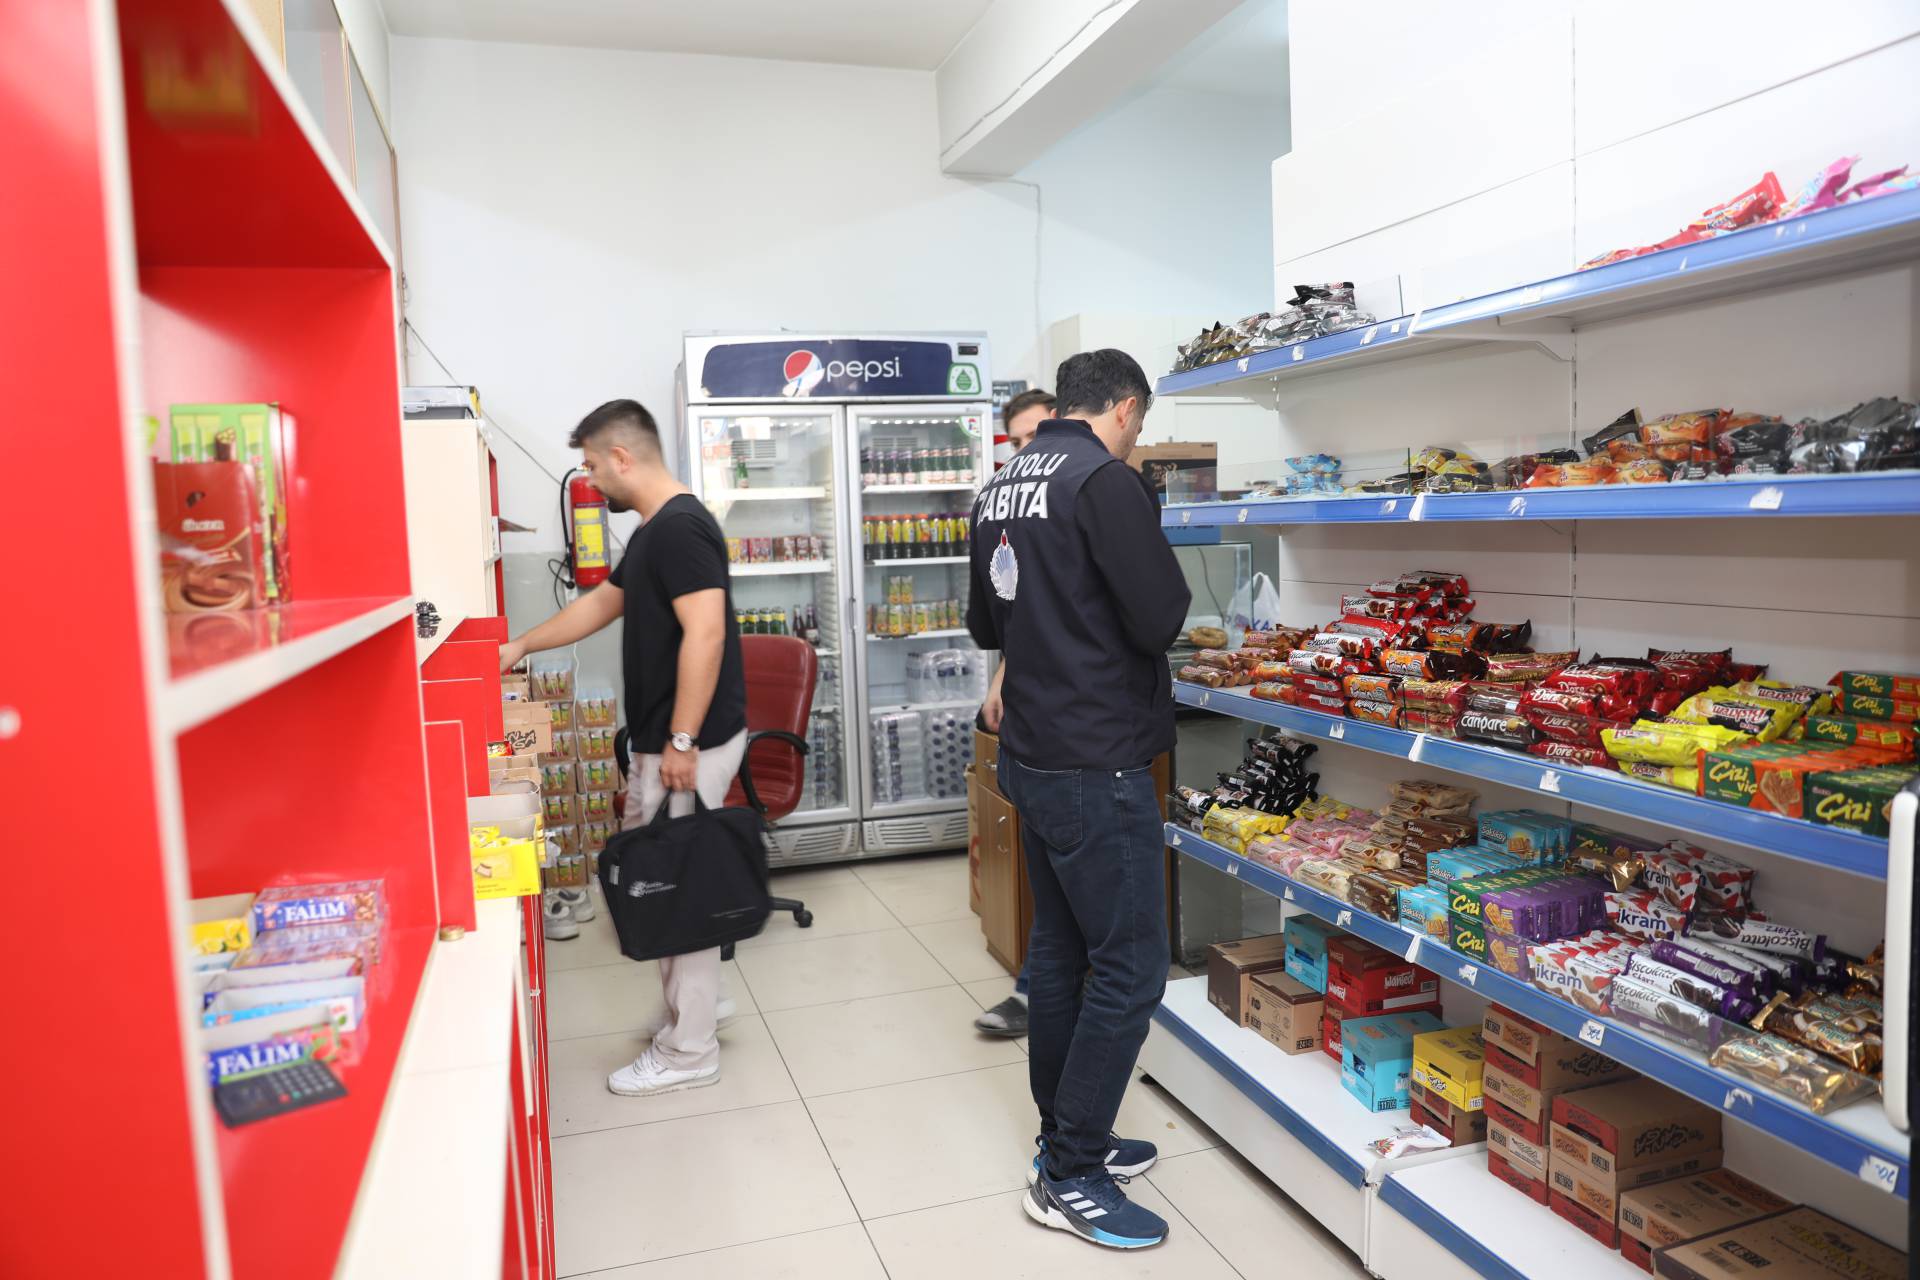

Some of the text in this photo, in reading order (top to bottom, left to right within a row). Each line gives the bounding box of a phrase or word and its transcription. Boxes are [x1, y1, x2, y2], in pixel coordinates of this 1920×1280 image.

[827, 357, 902, 383] pepsi
[976, 481, 1049, 527] ZABITA
[1461, 715, 1508, 733] canpare
[1709, 760, 1749, 782] Çizi
[1816, 792, 1873, 822] Çizi
[1644, 868, 1671, 887] kram
[1452, 894, 1480, 916] Çizi
[1616, 908, 1667, 931] ikram
[1456, 930, 1485, 953] Çizi
[1535, 963, 1582, 990] ikram
